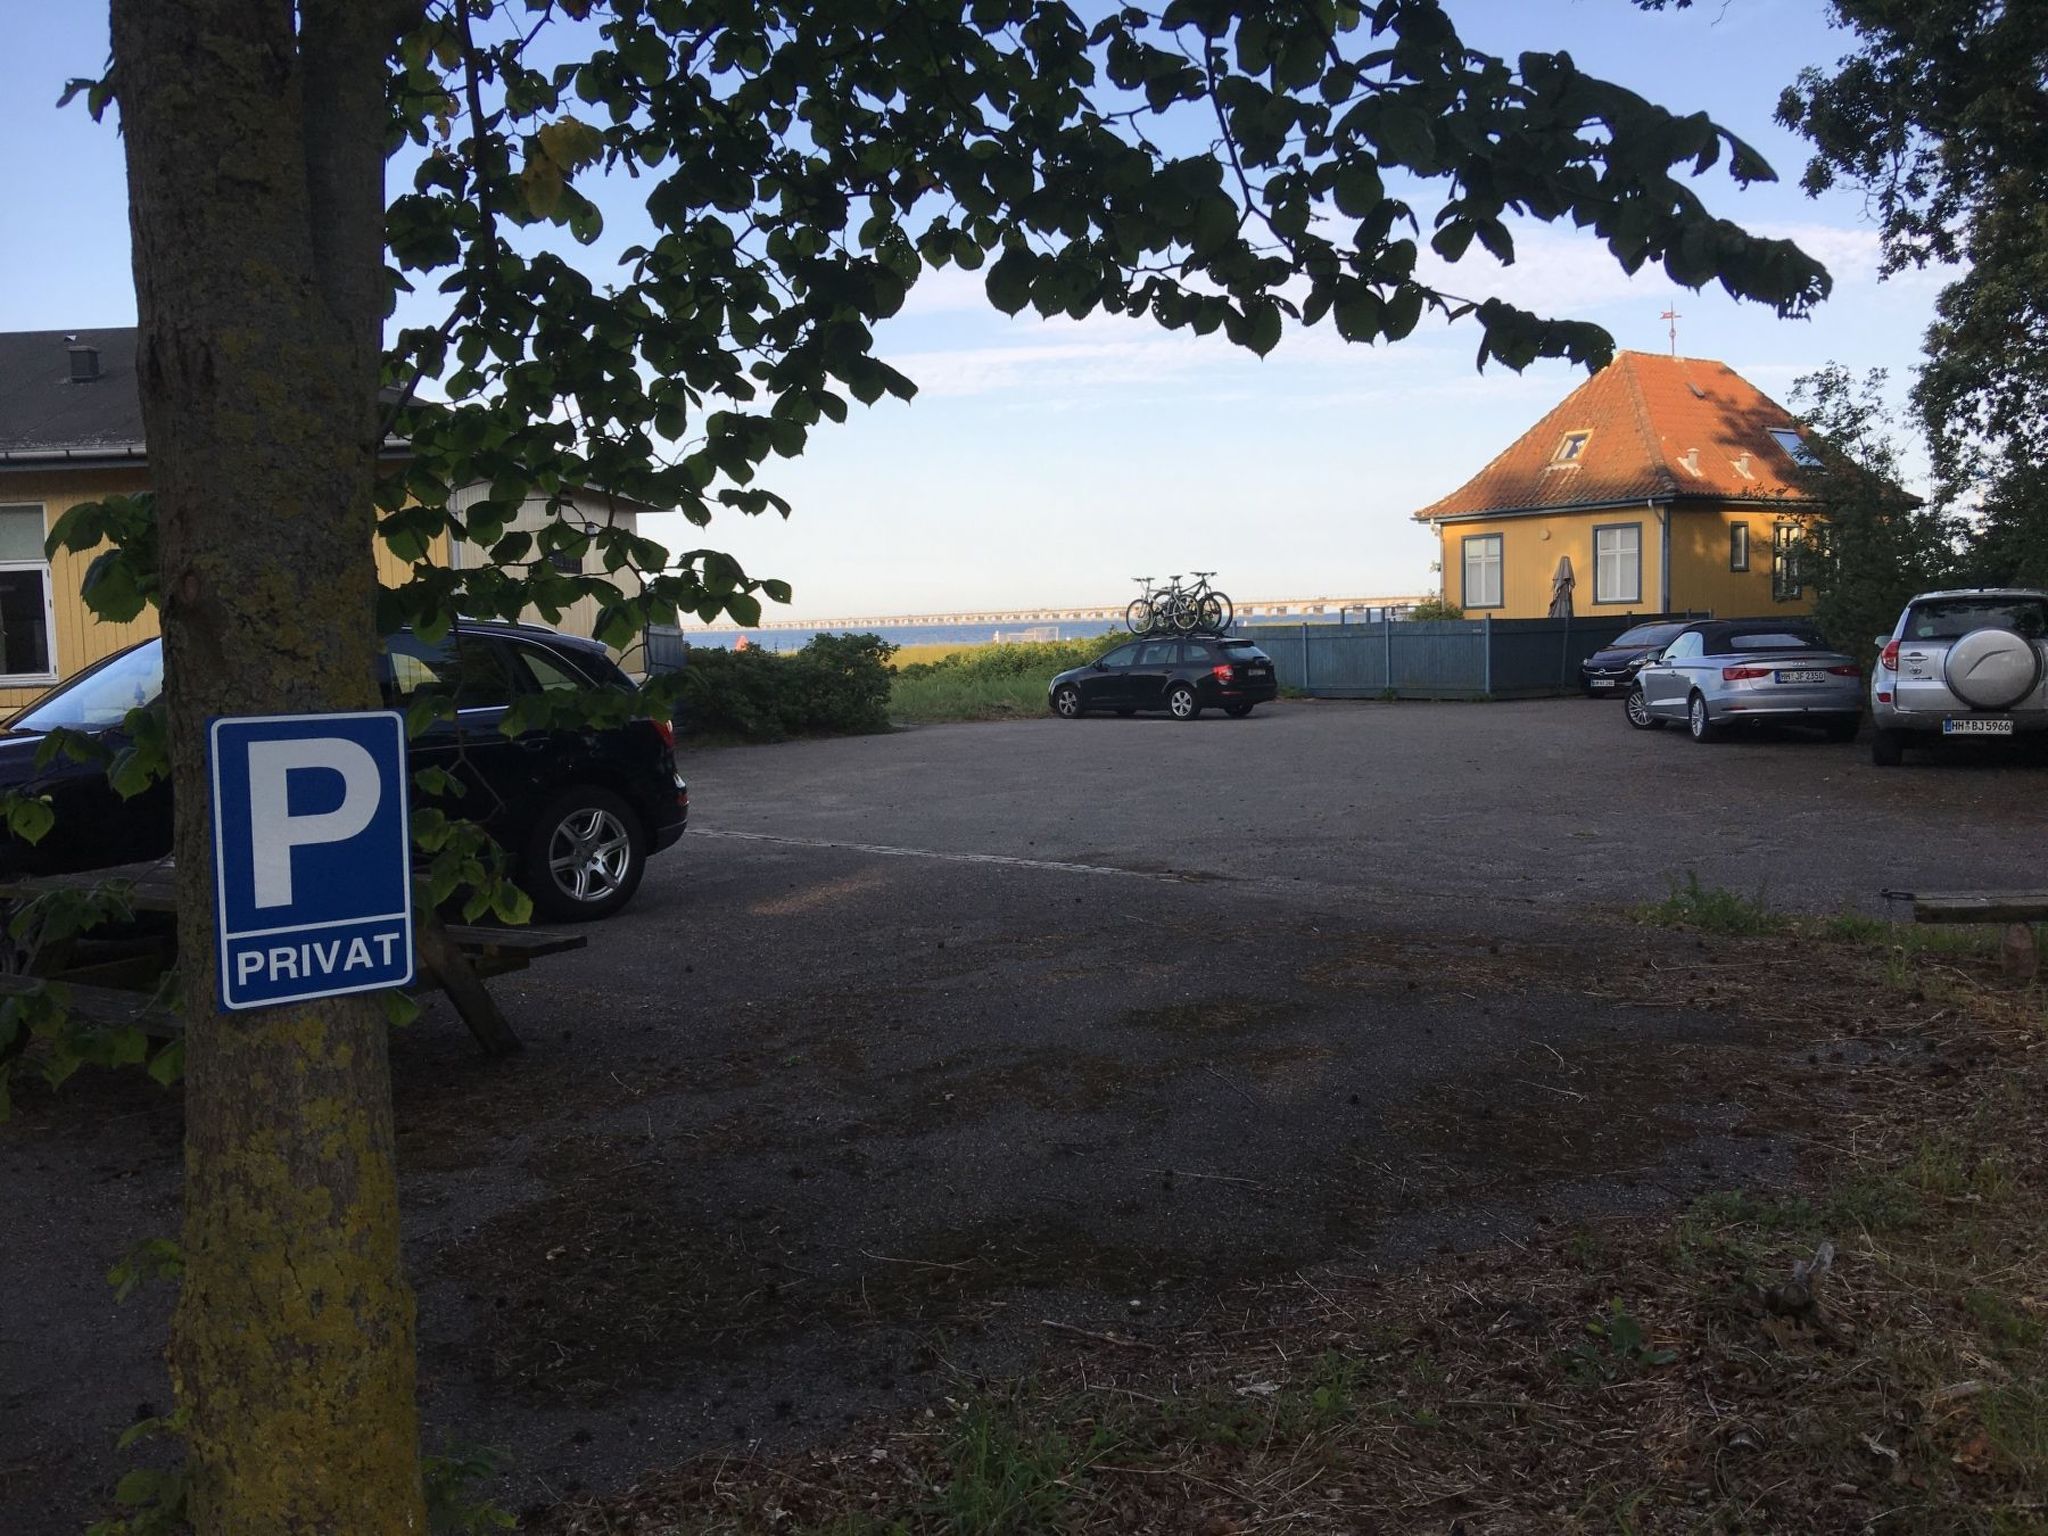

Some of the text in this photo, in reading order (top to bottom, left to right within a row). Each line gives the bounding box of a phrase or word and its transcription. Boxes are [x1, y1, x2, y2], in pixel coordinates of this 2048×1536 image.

[1952, 721, 1965, 731] HH
[247, 737, 381, 909] P
[236, 932, 400, 986] PRIVAT
